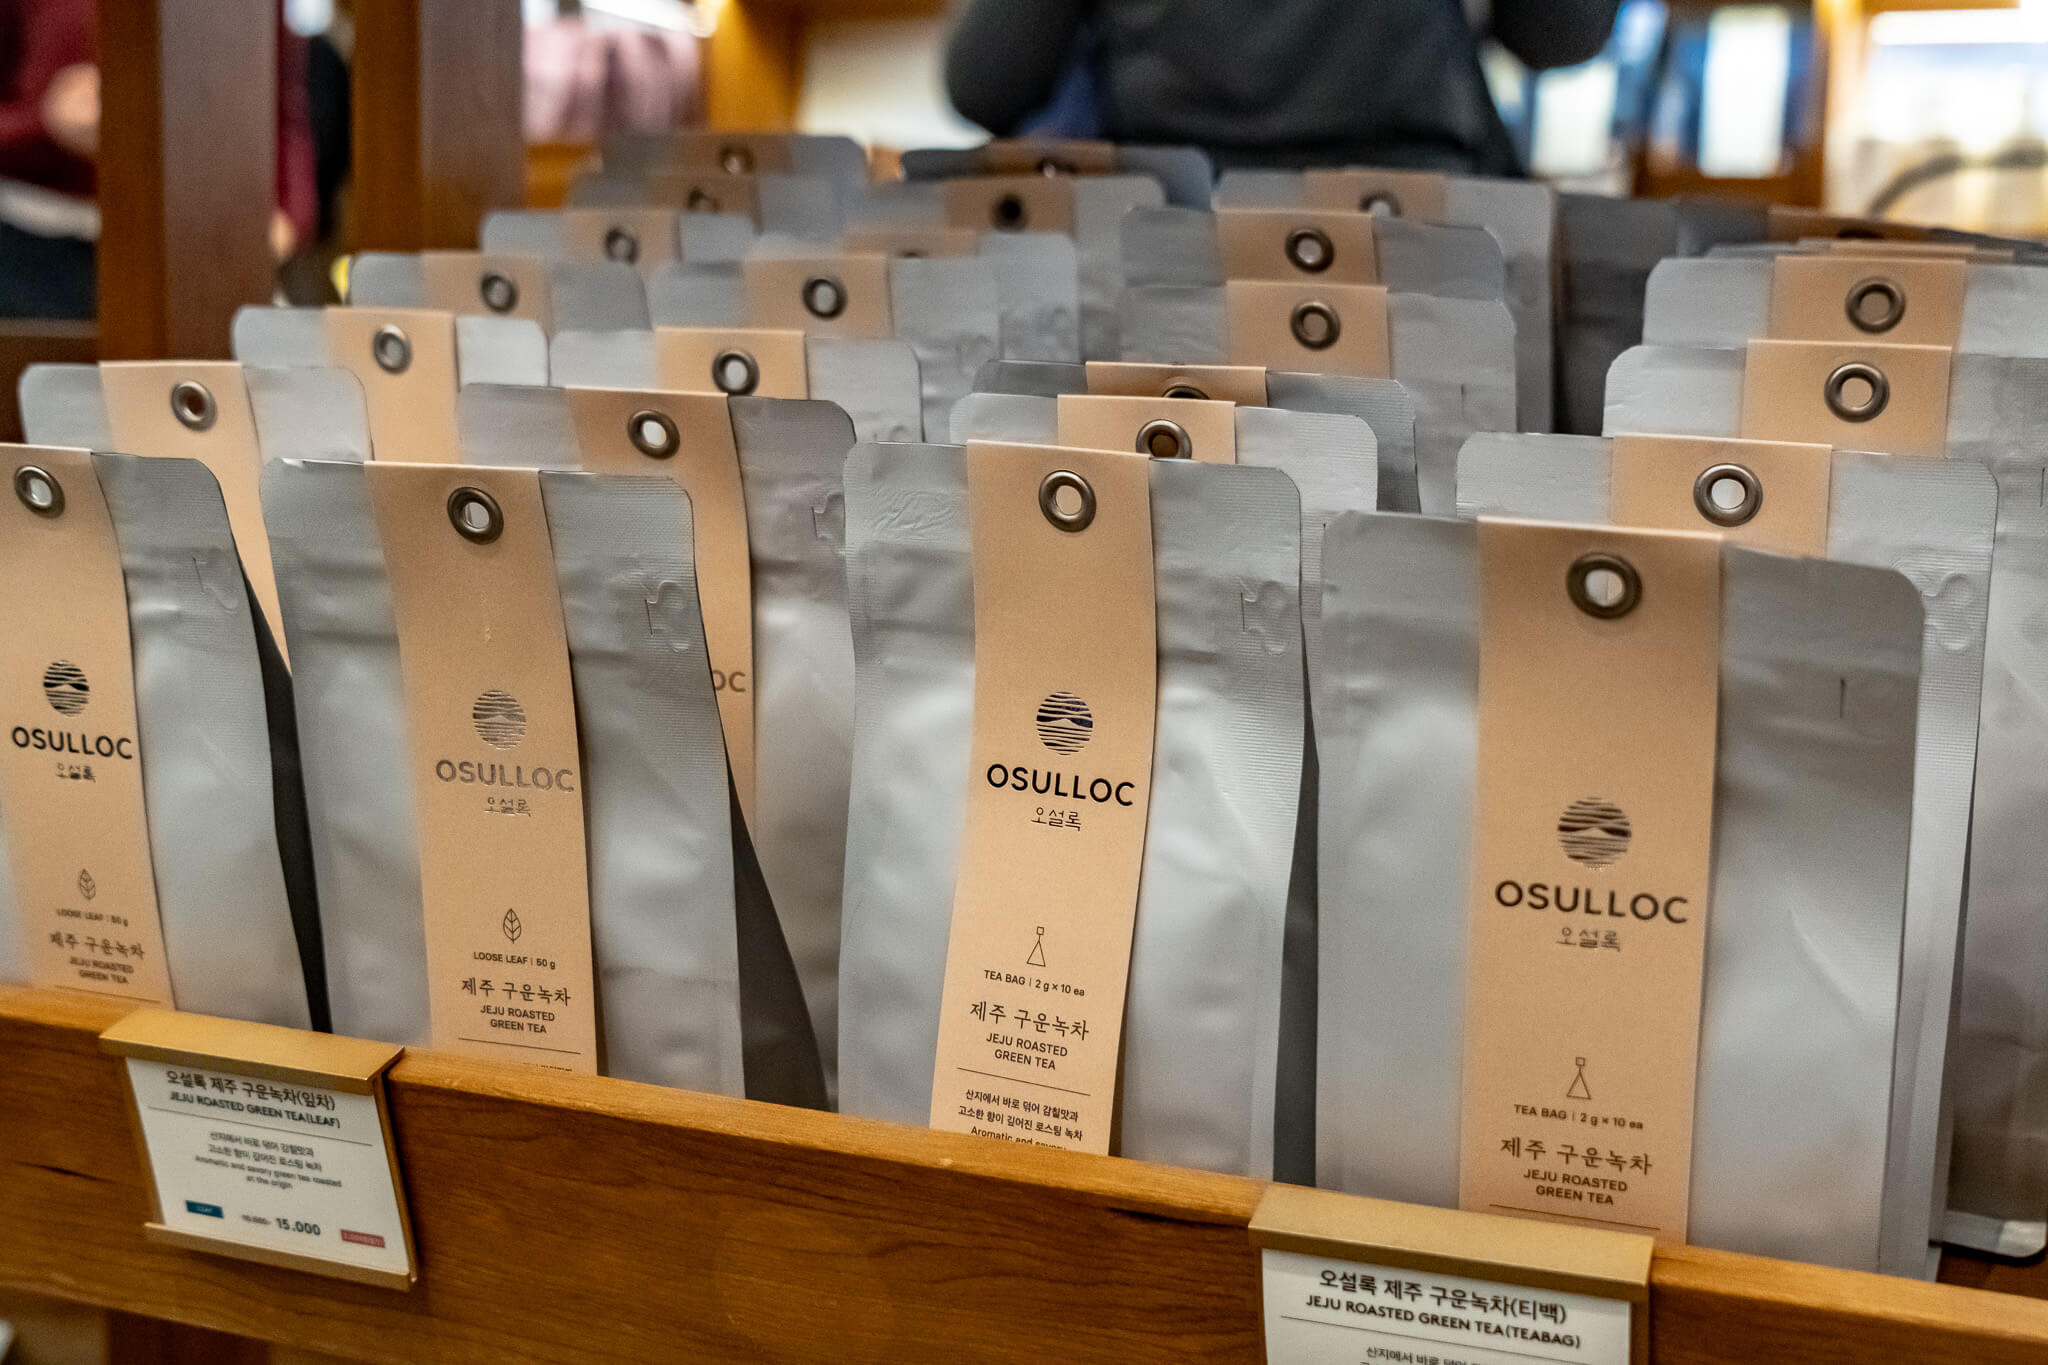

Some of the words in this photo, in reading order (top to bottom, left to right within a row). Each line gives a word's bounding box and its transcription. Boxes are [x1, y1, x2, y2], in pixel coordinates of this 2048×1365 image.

[12, 726, 133, 759] OSULLOC
[56, 762, 96, 783] 오설록
[435, 759, 575, 792] OSULLOC
[986, 763, 1135, 807] OSULLOC
[482, 796, 531, 817] 오설록
[1030, 806, 1082, 832] 오설록
[1495, 880, 1688, 925] OSULLOC
[84, 936, 145, 960] 구운녹차
[1556, 926, 1620, 952] 오설록
[473, 951, 503, 962] LOOSE
[505, 954, 528, 965] LEAF
[536, 958, 548, 967] 50
[550, 961, 556, 970] g
[461, 977, 495, 998] 제주
[502, 981, 571, 1007] 구운녹차
[984, 969, 1003, 982] TEA
[1005, 973, 1026, 986] BAG
[1035, 979, 1041, 989] 2
[1043, 982, 1050, 993] g
[1060, 983, 1072, 994] 10
[1073, 987, 1085, 997] ea
[480, 1005, 505, 1016] JEJU
[507, 1007, 556, 1022] ROASTED
[490, 1018, 525, 1031] GREEN
[527, 1022, 548, 1034] TEA
[970, 1000, 1007, 1024] 제주
[1013, 1008, 1090, 1041] 구운녹차
[986, 1032, 1013, 1046] JEJU
[1016, 1037, 1068, 1057] ROASTED
[994, 1048, 1032, 1065] GREEN
[1034, 1056, 1056, 1070] TEA
[166, 1070, 207, 1090] 오설록
[210, 1076, 237, 1095] 제주
[170, 1091, 194, 1104] JEJU
[196, 1095, 244, 1112] ROASTED
[246, 1104, 283, 1118] GREEN
[966, 1088, 1000, 1106] 산지에서
[1002, 1096, 1020, 1109] 바로
[1043, 1104, 1079, 1122] 감칠맛과
[1514, 1104, 1537, 1116] TEA
[1541, 1107, 1567, 1120] BAG
[1580, 1112, 1587, 1123] 2
[1590, 1116, 1598, 1127] g
[1613, 1117, 1626, 1127] 10
[1629, 1121, 1644, 1130] ea
[958, 1105, 985, 1120] 고소한
[987, 1110, 1004, 1125] 향이
[1007, 1115, 1033, 1131] 깊어진
[1035, 1121, 1062, 1137] 로스팅
[1065, 1127, 1083, 1142] 녹차
[1500, 1136, 1546, 1161] 제주
[1556, 1143, 1653, 1176] 구운녹차
[1523, 1169, 1557, 1182] JEJU
[1562, 1173, 1628, 1192] ROASTED
[1535, 1185, 1583, 1201] GREEN
[1587, 1191, 1614, 1205] TEA
[1319, 1269, 1377, 1296] 오설록
[1383, 1279, 1423, 1302] 제주
[1430, 1285, 1567, 1324] 구운녹차(티백)
[1306, 1294, 1341, 1310] JEJU
[1346, 1300, 1414, 1321] ROASTED
[1418, 1312, 1470, 1330] GREEN
[1475, 1320, 1581, 1349] TEA(TEABAG)
[1366, 1345, 1413, 1364] 산지에서
